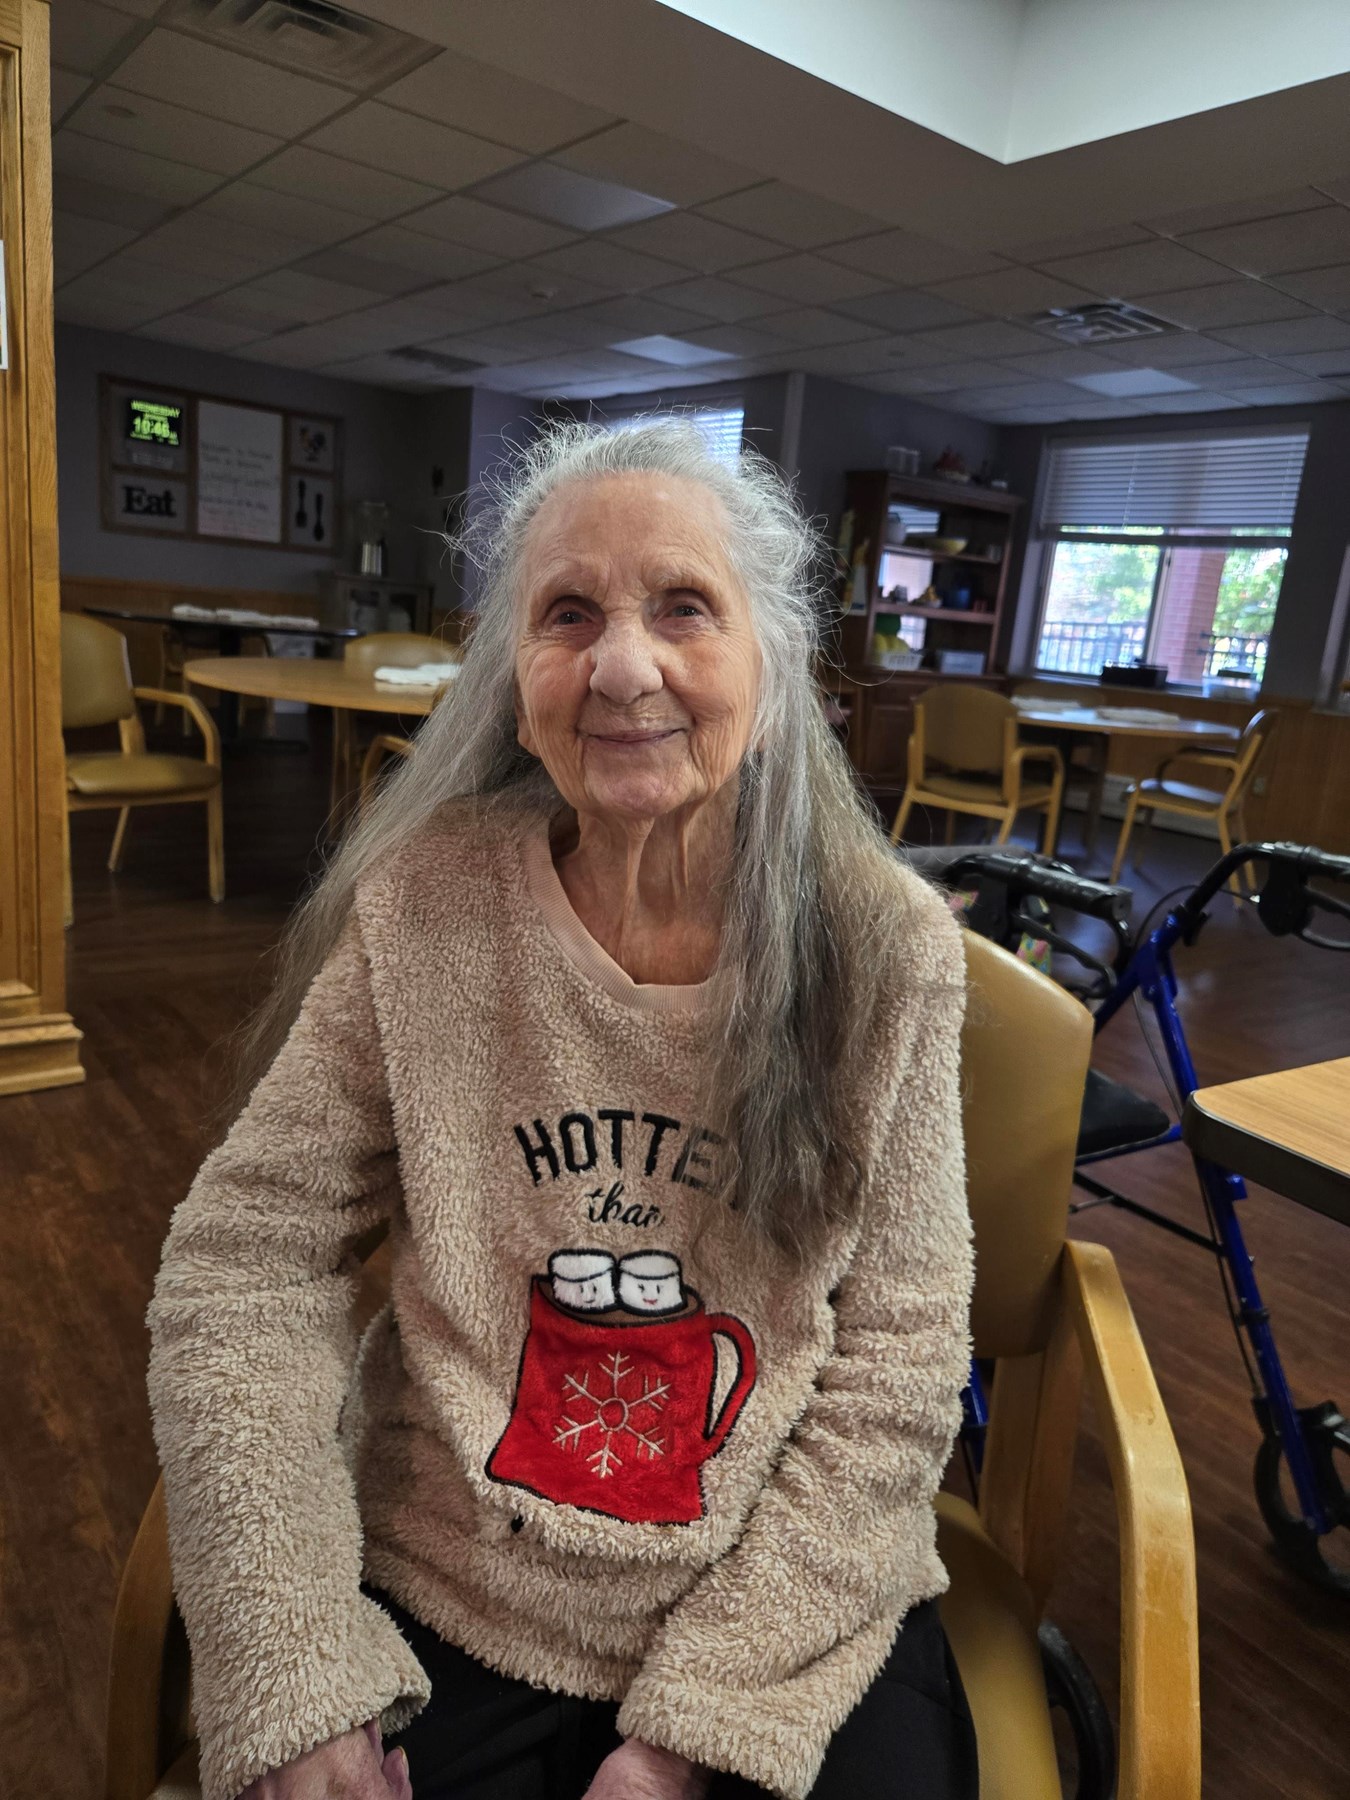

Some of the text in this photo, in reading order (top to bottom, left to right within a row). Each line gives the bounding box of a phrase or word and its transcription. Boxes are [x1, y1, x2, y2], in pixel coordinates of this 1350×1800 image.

[125, 486, 176, 517] Eat
[513, 1109, 738, 1208] HOTTE
[587, 1181, 666, 1228] than
